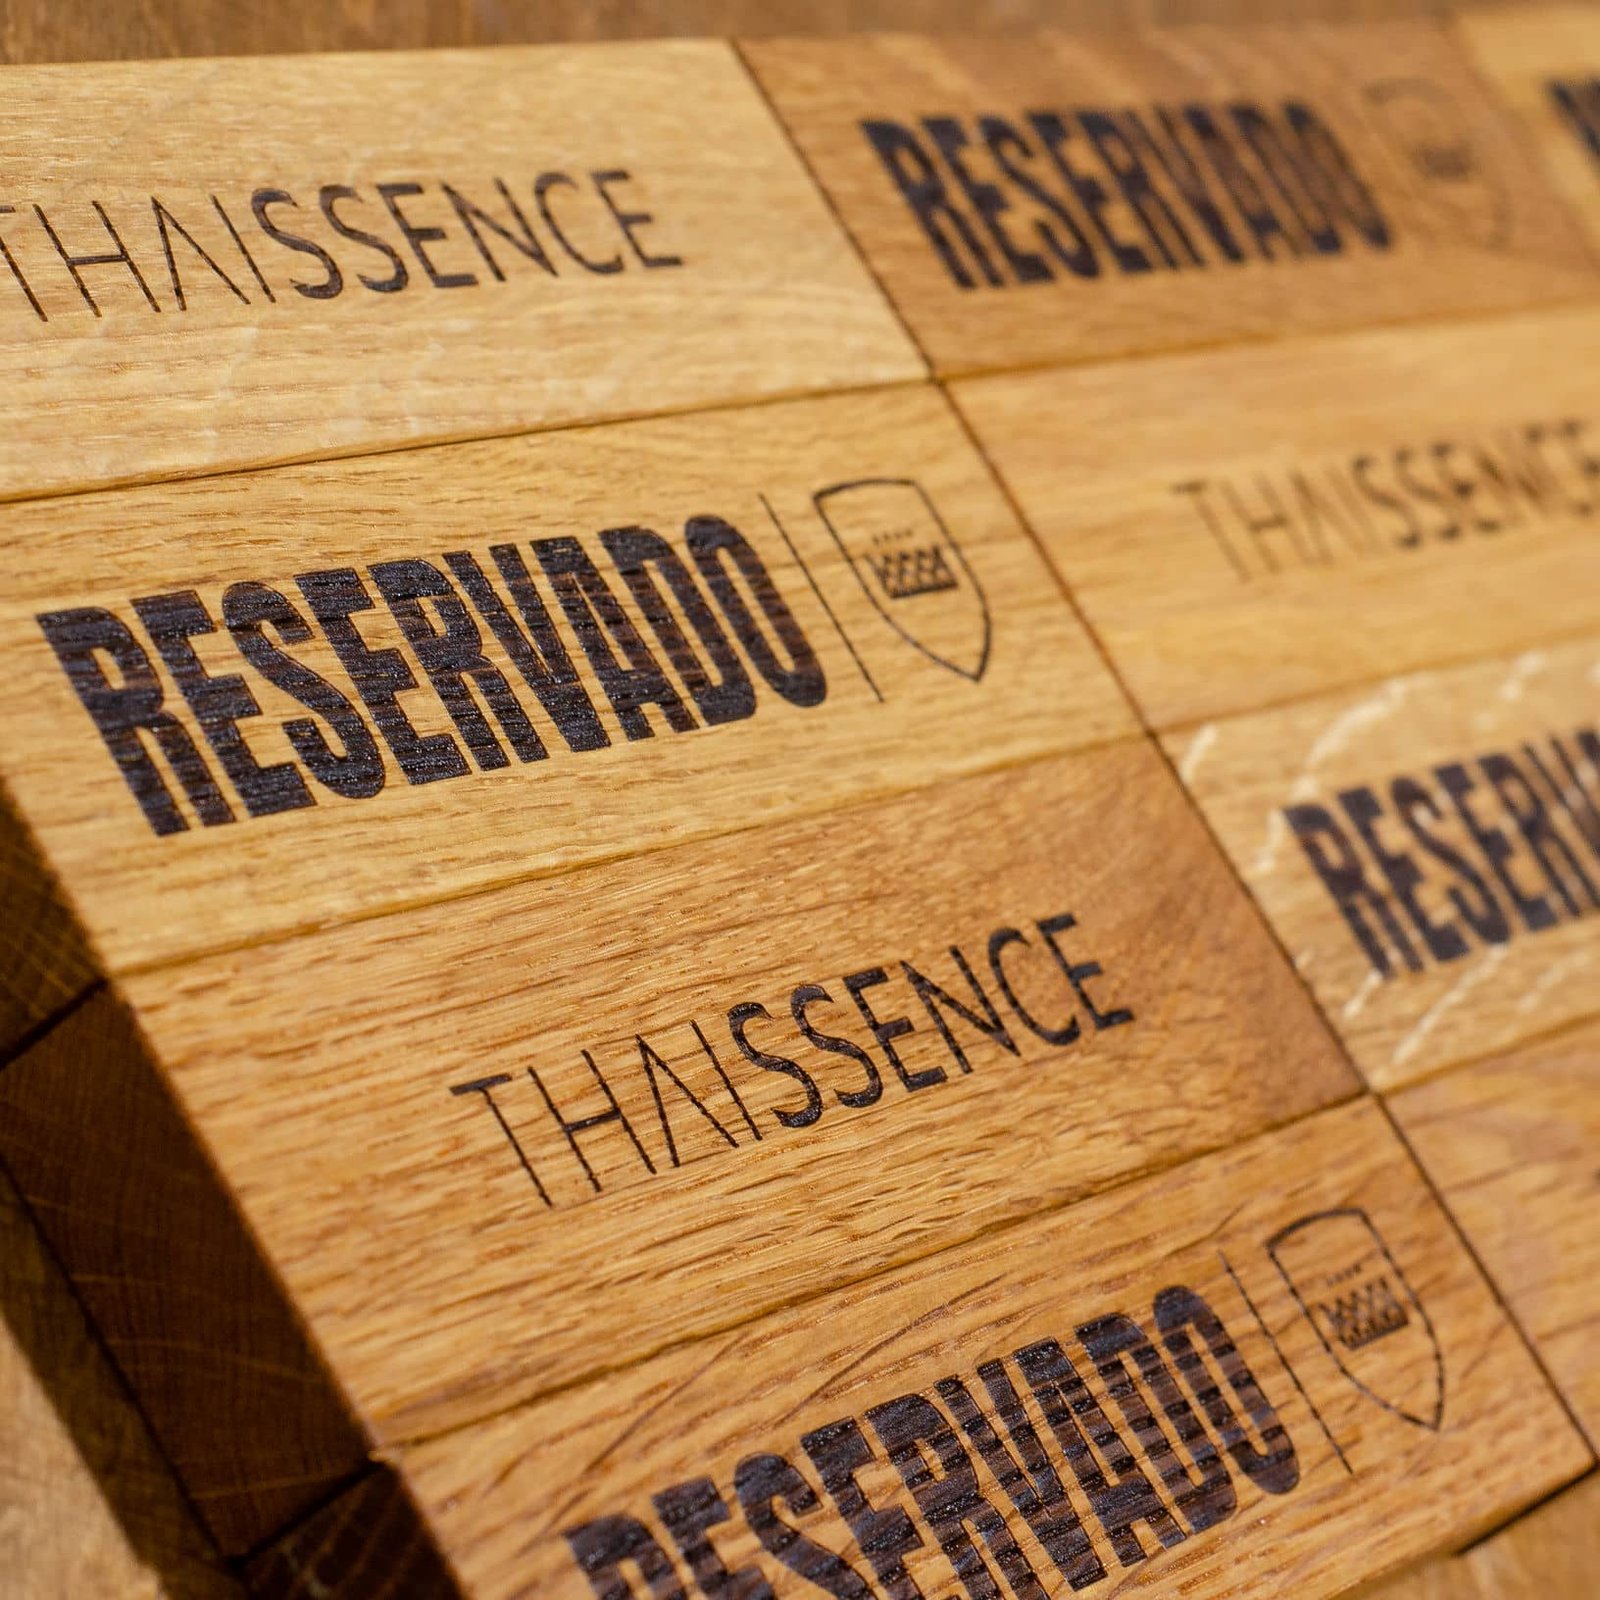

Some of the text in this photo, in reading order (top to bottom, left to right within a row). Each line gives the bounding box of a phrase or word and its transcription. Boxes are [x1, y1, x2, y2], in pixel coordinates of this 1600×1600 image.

[860, 102, 1392, 290] RESERVADO
[36, 514, 827, 837] RESERVADO
[1283, 730, 1600, 982] RESERV
[450, 913, 1135, 1208] THAISSENCE
